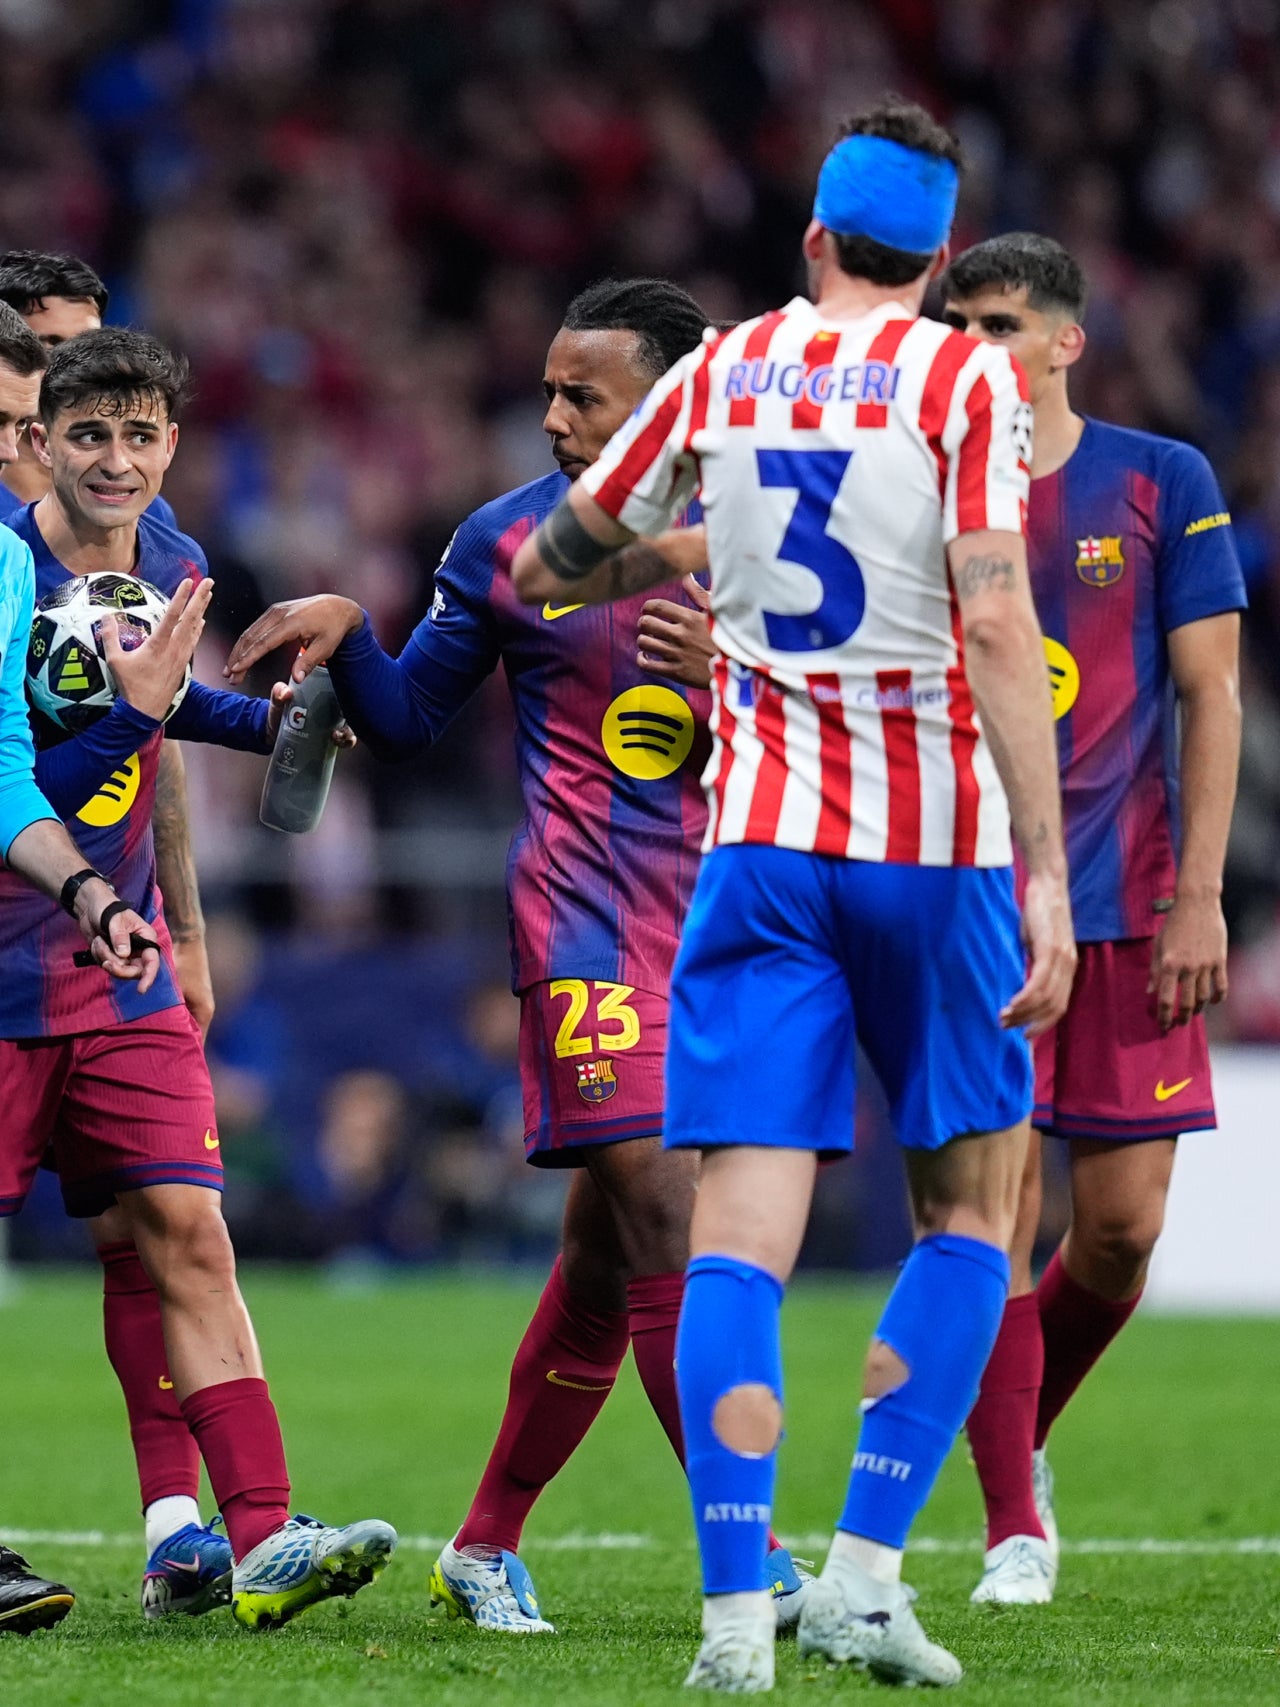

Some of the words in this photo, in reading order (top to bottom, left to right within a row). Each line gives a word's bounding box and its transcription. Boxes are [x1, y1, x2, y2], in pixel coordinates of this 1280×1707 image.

[724, 359, 901, 402] RUGGERI
[755, 448, 866, 651] 3
[289, 706, 307, 730] G
[549, 979, 640, 1059] 23
